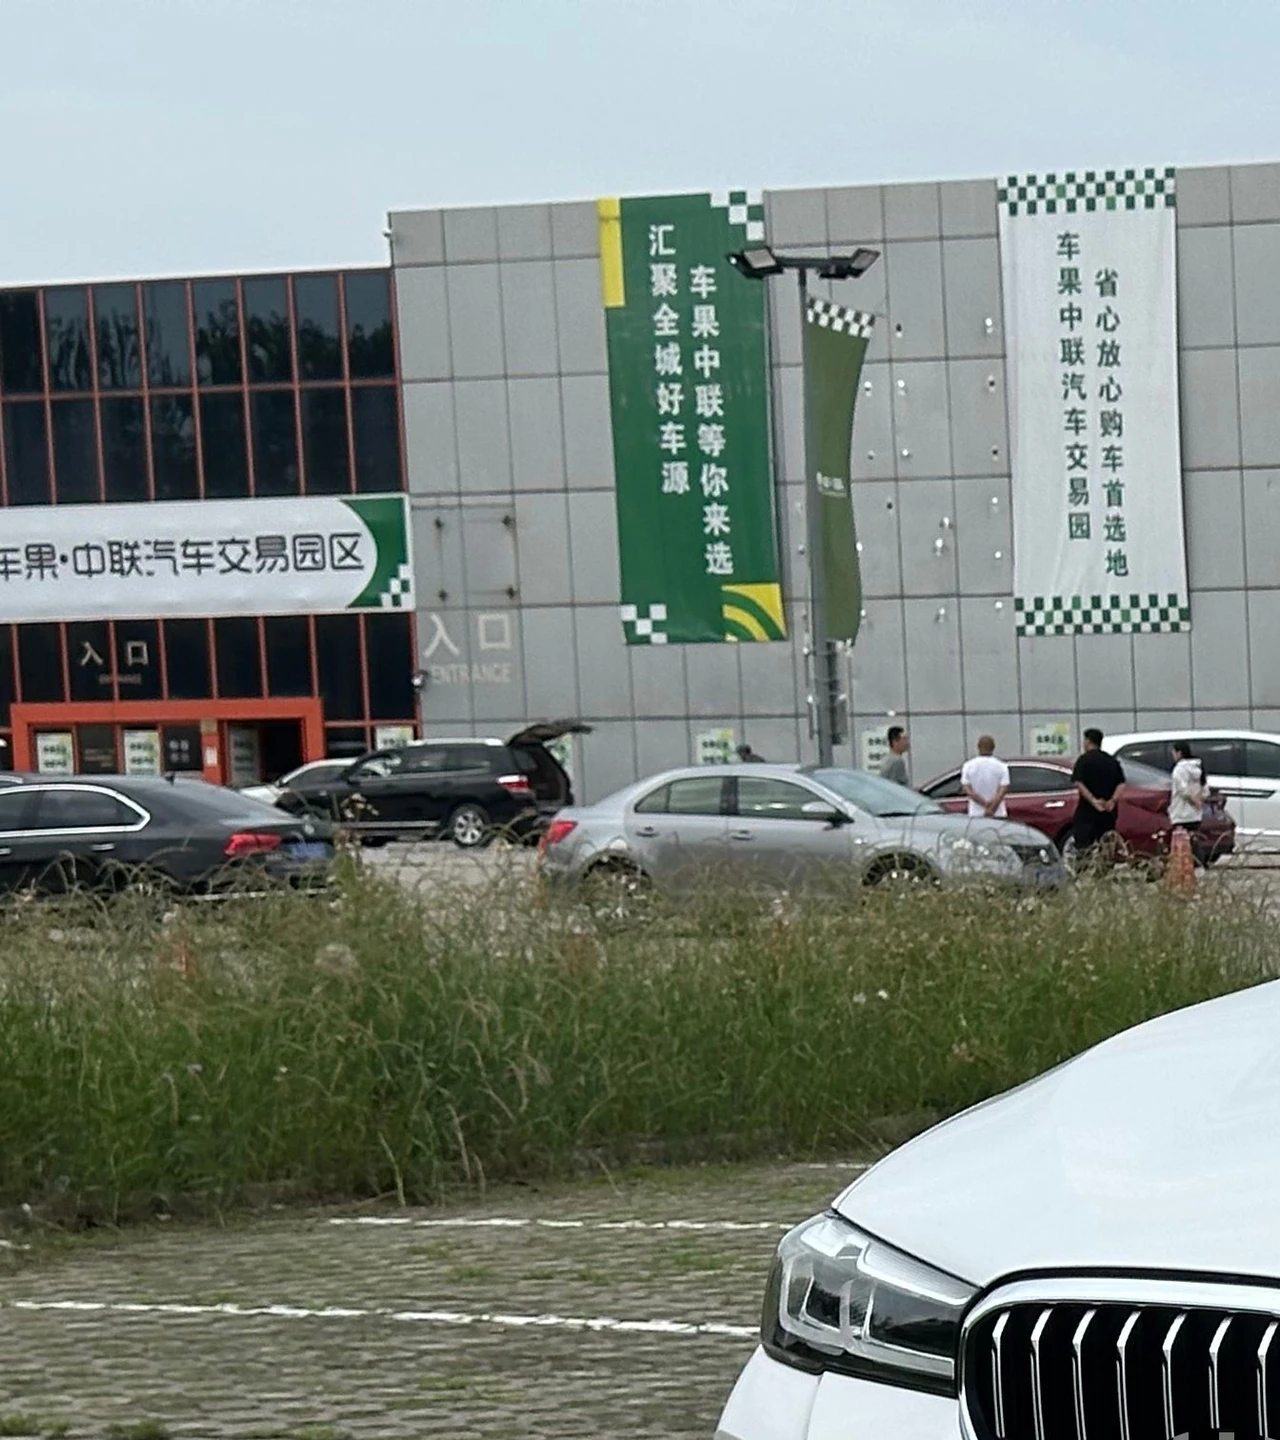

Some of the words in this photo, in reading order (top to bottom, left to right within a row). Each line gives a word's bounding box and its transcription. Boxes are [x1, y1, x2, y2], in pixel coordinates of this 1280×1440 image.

[647, 223, 690, 495] 汇聚全城好车源
[689, 264, 734, 575] 车果中联等你来选
[1056, 230, 1091, 540] 车果中联汽车交易园
[1094, 268, 1129, 578] 省心放心购车首选地
[79, 640, 149, 667] 入口
[423, 612, 512, 658] 入口
